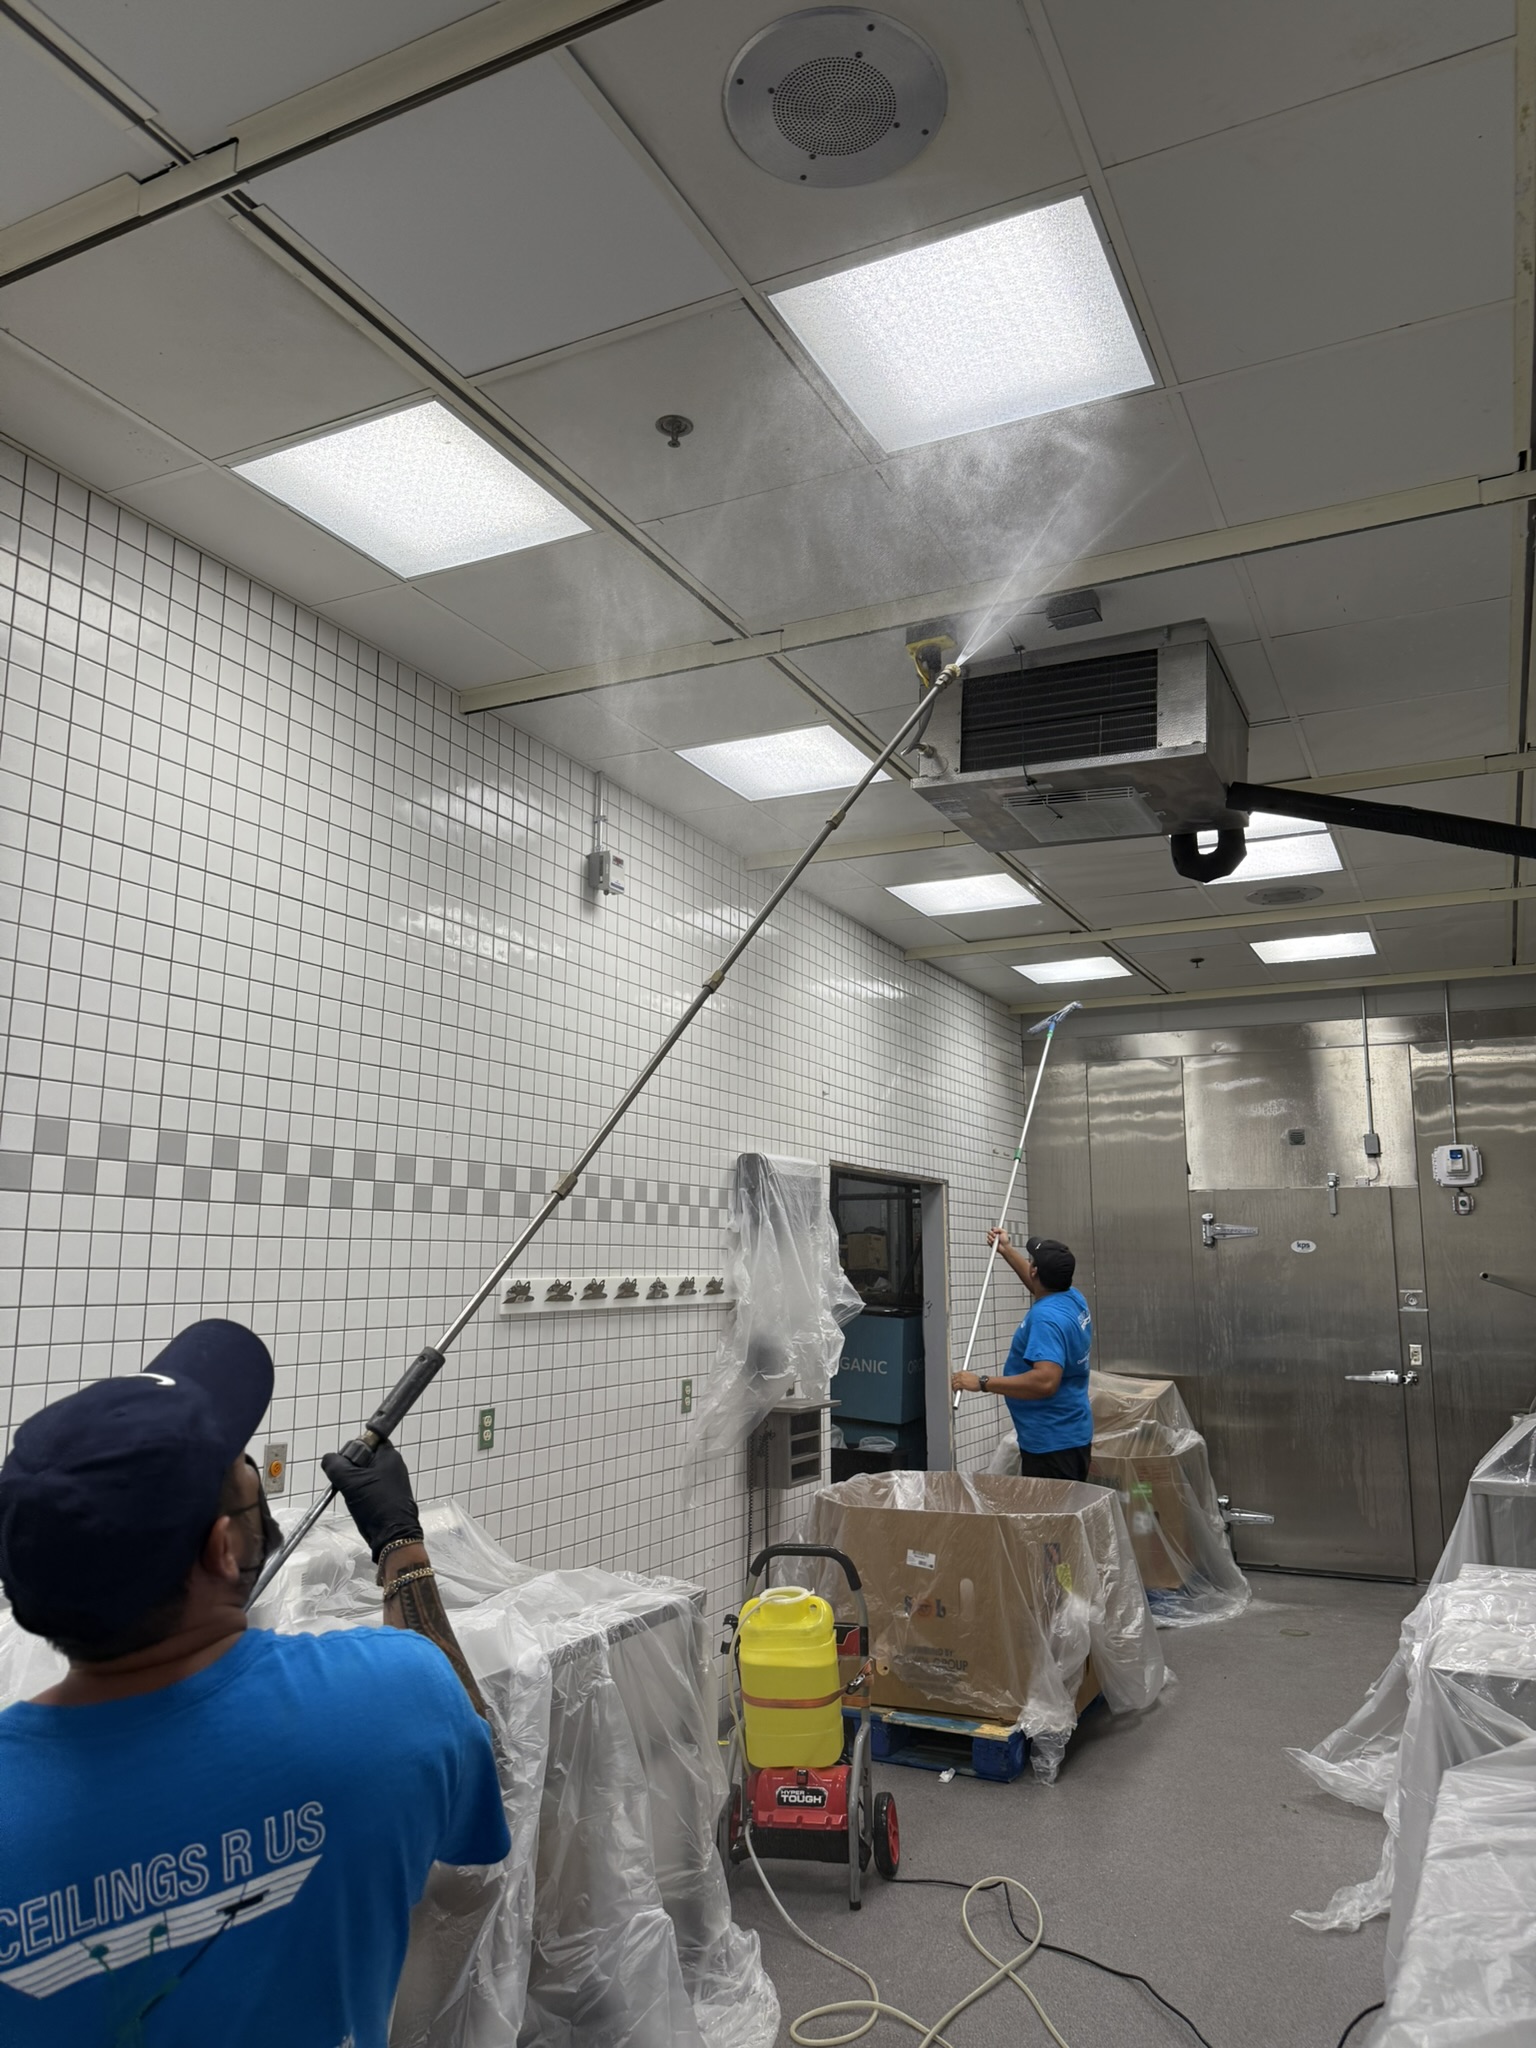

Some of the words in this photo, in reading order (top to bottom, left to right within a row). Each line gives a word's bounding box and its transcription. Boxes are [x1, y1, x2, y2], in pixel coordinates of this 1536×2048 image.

[1296, 1241, 1311, 1250] kps
[840, 1356, 888, 1375] GANIC
[781, 1795, 822, 1804] TOUGH
[0, 1843, 209, 1965] CEILINGS
[221, 1828, 252, 1883] R
[264, 1800, 327, 1864] US
